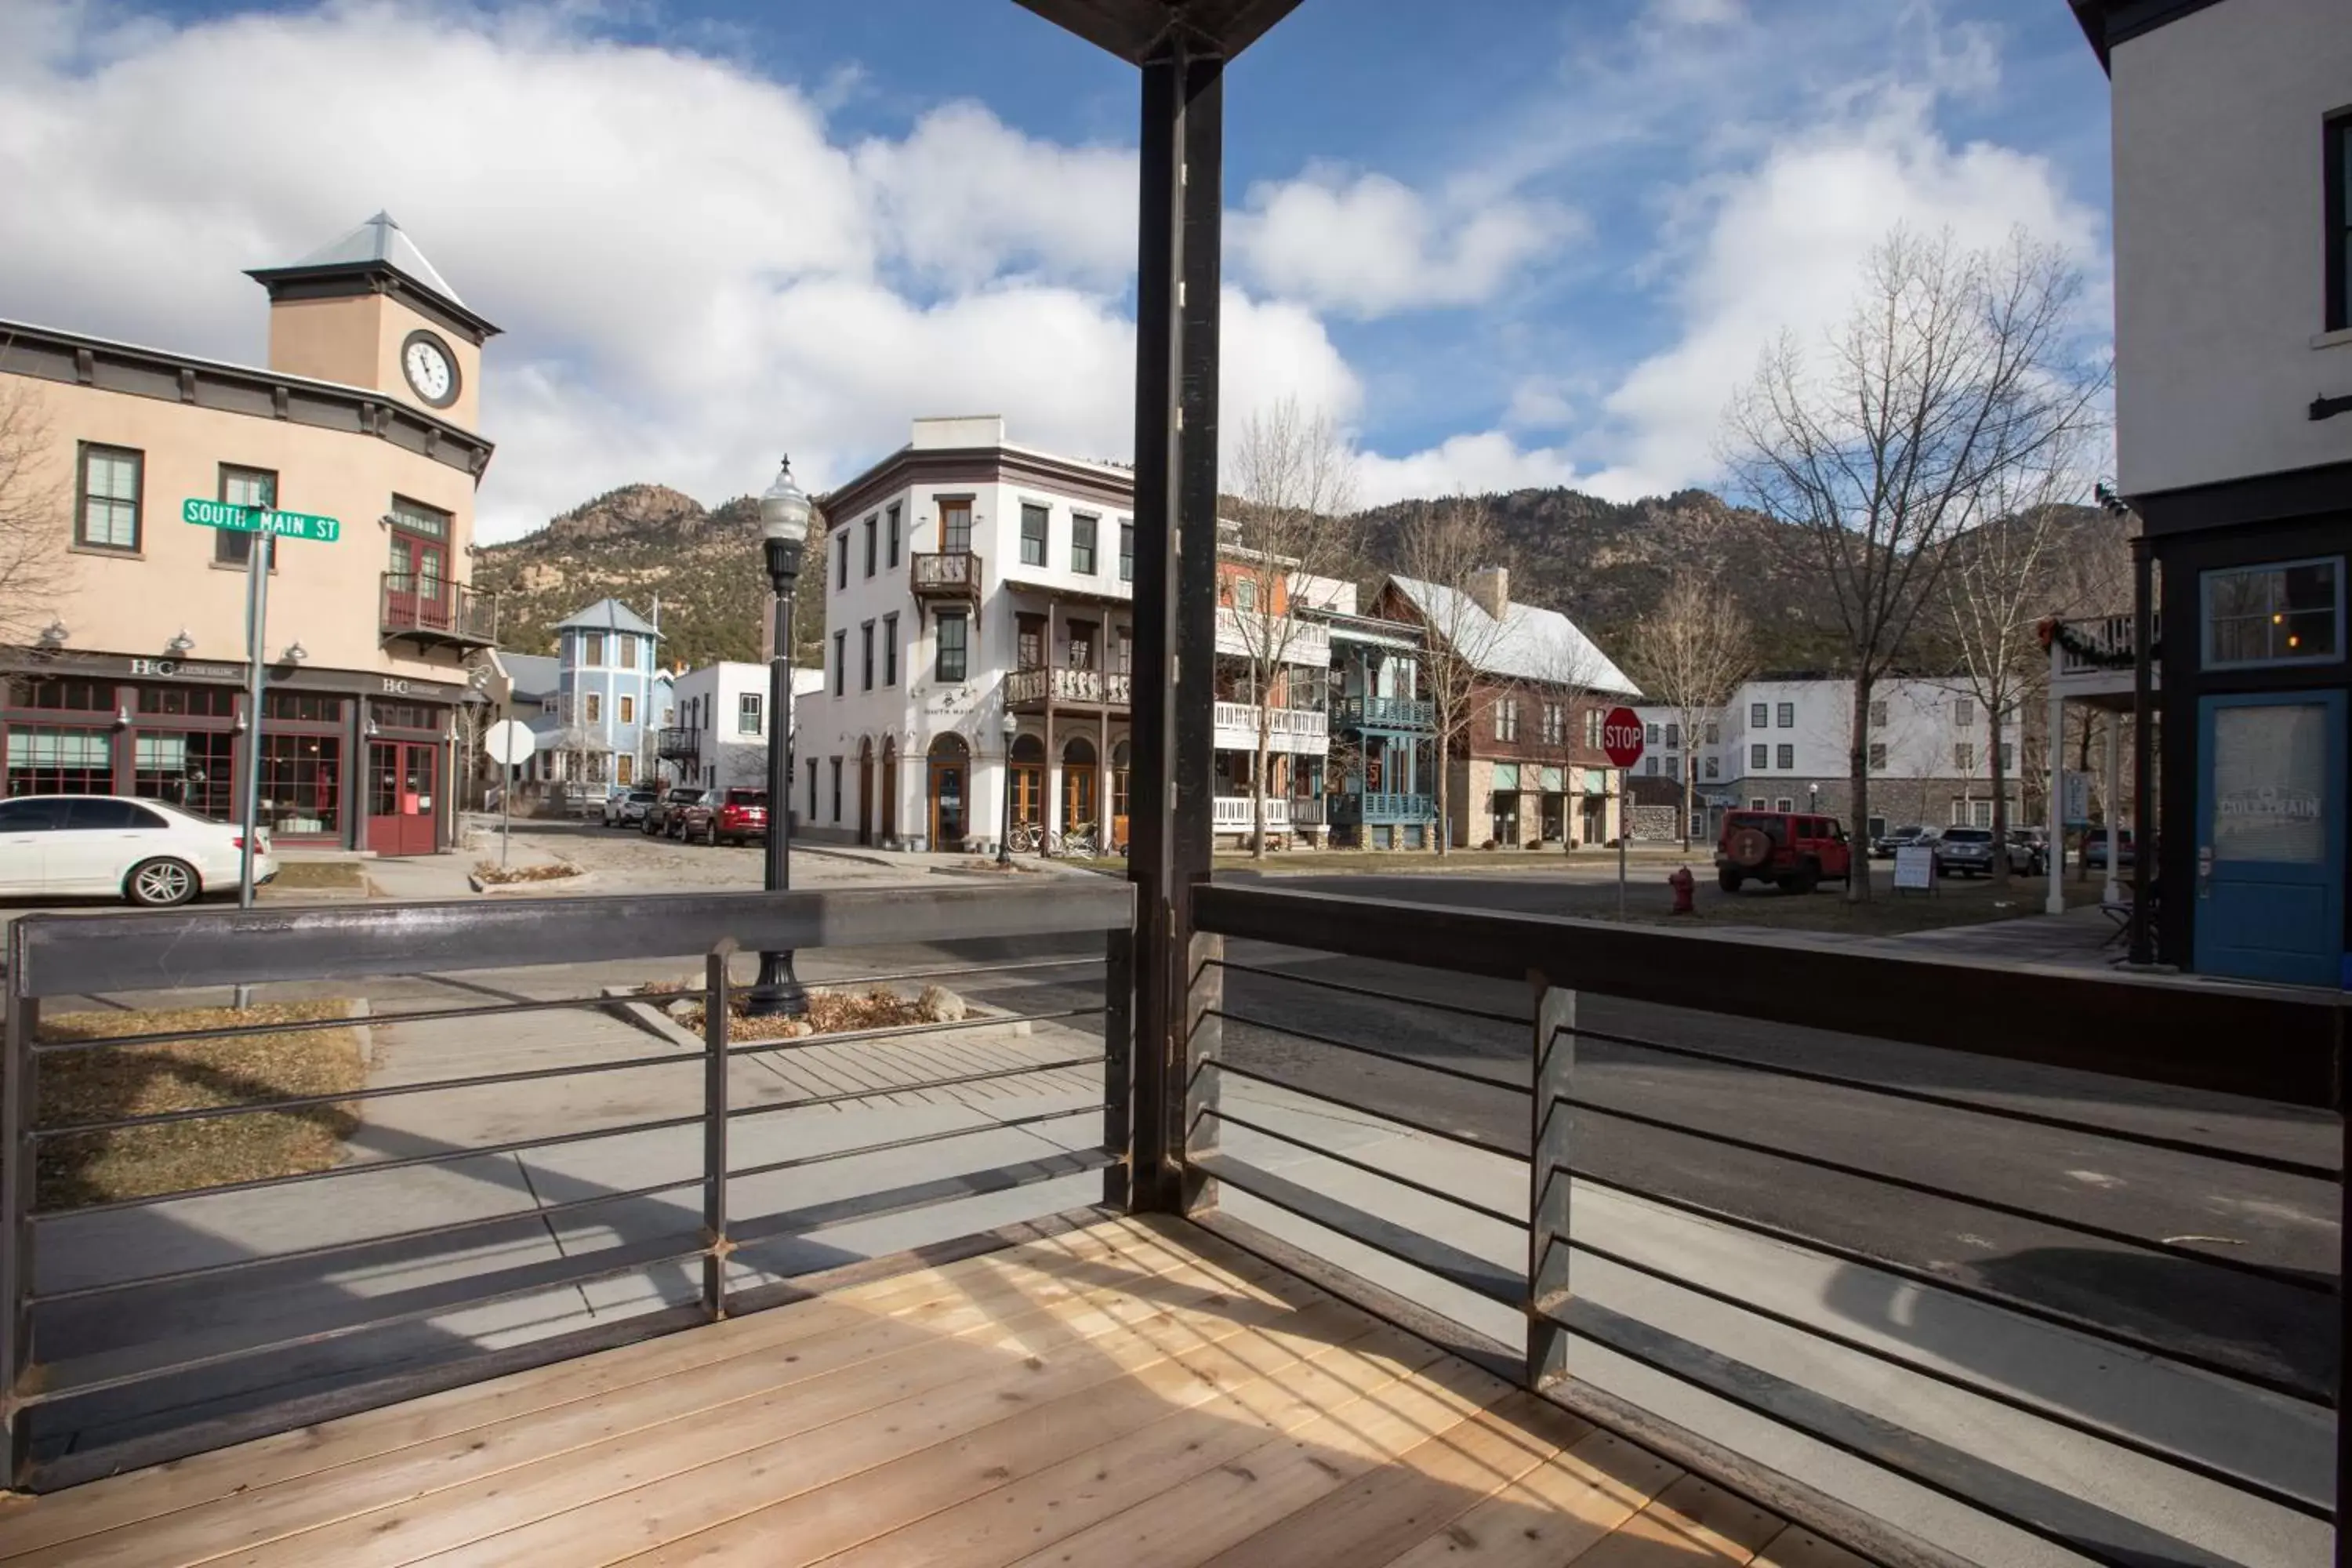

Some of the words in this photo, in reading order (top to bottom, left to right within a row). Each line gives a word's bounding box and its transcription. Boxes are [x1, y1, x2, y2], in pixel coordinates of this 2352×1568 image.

[187, 501, 246, 528] SOUTH
[260, 511, 305, 535] MAIN
[316, 519, 337, 539] ST
[1606, 725, 1641, 750] STOP
